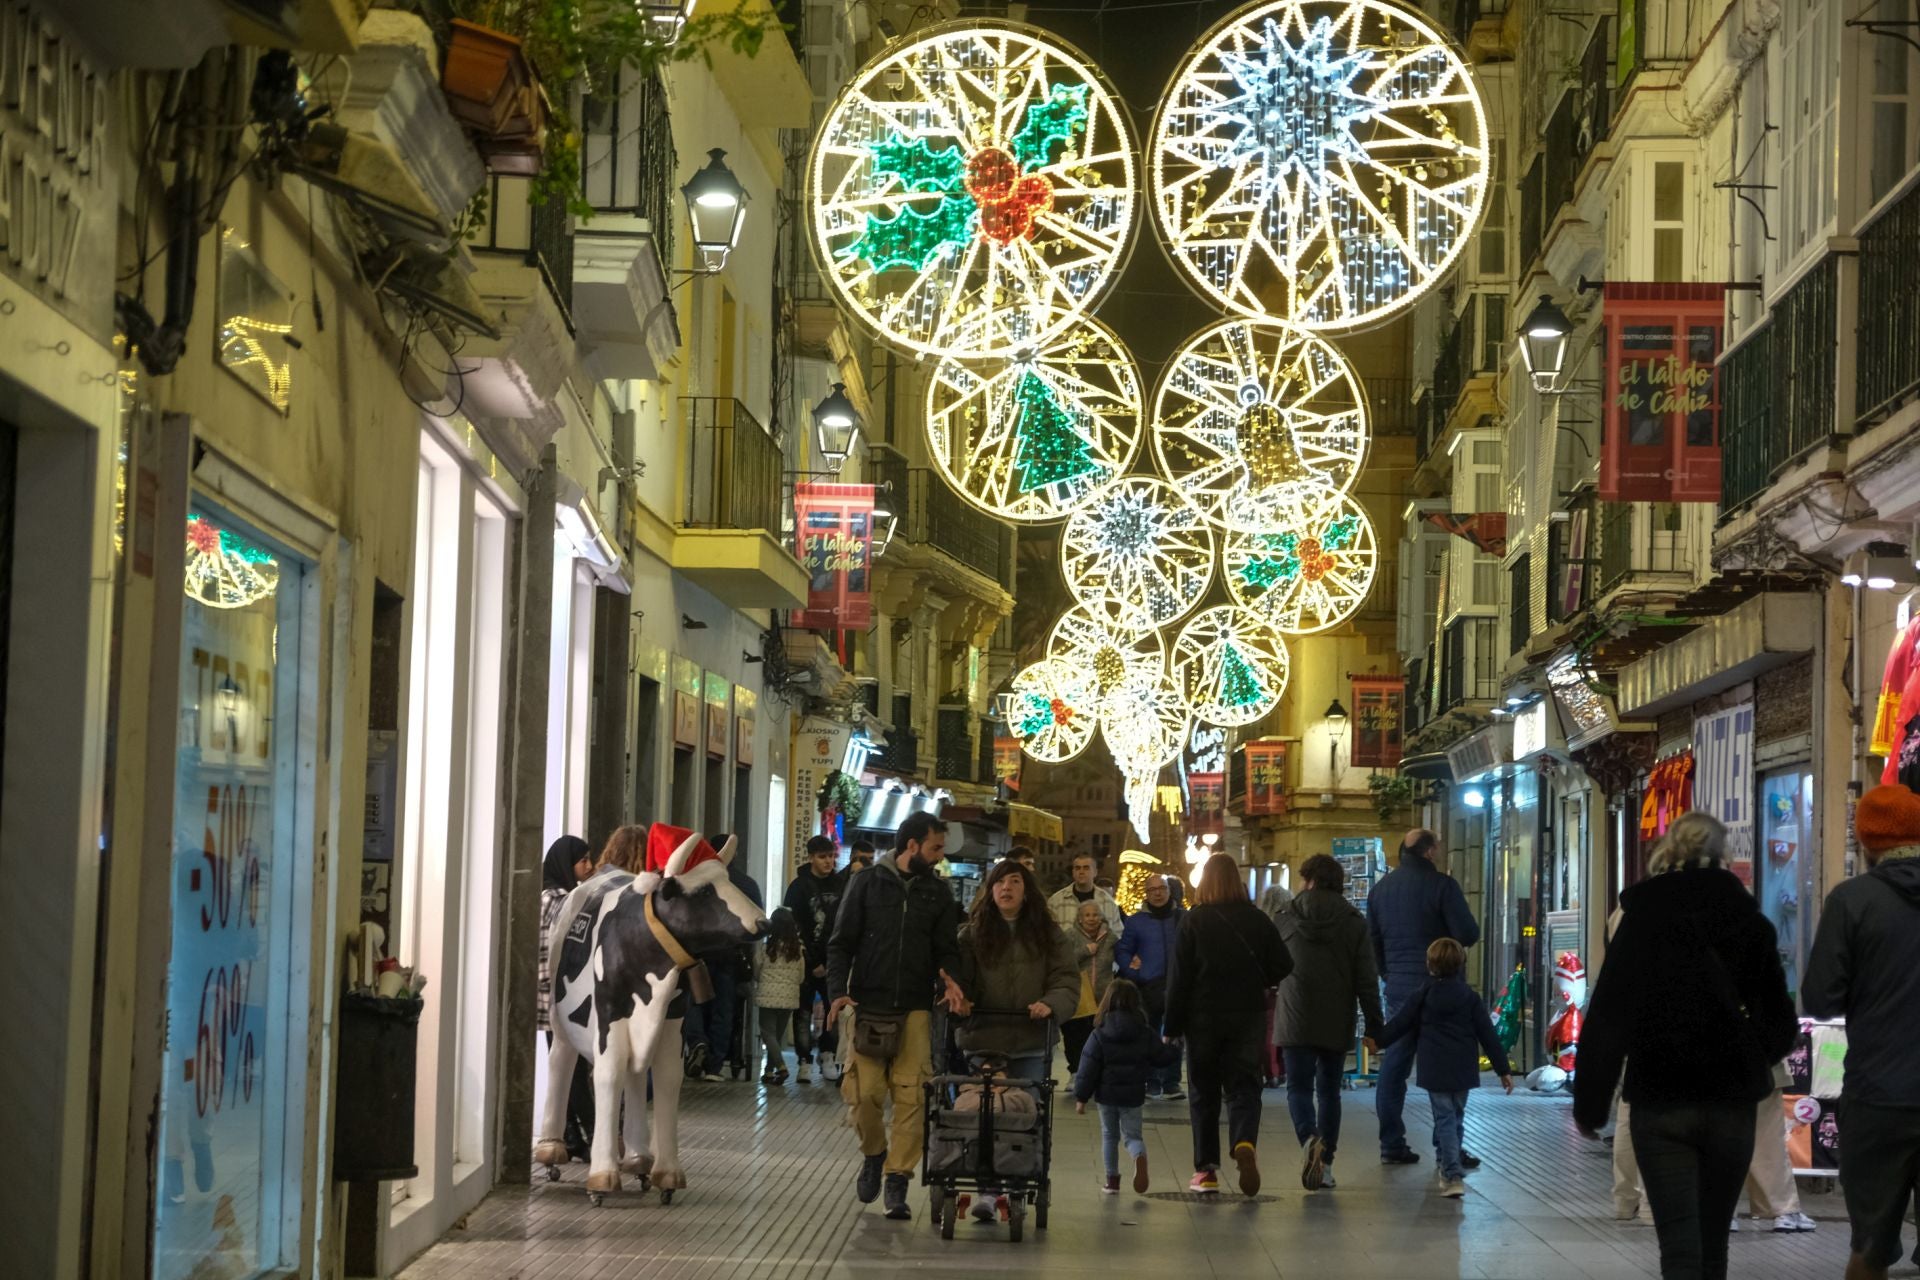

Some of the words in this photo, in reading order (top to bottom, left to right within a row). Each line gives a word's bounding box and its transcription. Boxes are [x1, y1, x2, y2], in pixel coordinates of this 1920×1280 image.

[1620, 360, 1641, 385] El
[1648, 355, 1711, 386] latido
[1616, 387, 1644, 411] de
[1651, 389, 1711, 415] Cádiz
[805, 534, 818, 551] El
[823, 532, 864, 552] latido
[801, 553, 820, 568] de
[825, 555, 864, 572] Cádiz
[1692, 709, 1752, 823] OUTLET
[1639, 787, 1658, 838] 4
[190, 784, 260, 932] -50%
[184, 959, 254, 1119] -60%
[1803, 1021, 1814, 1035] 2
[1798, 1104, 1814, 1121] 2
